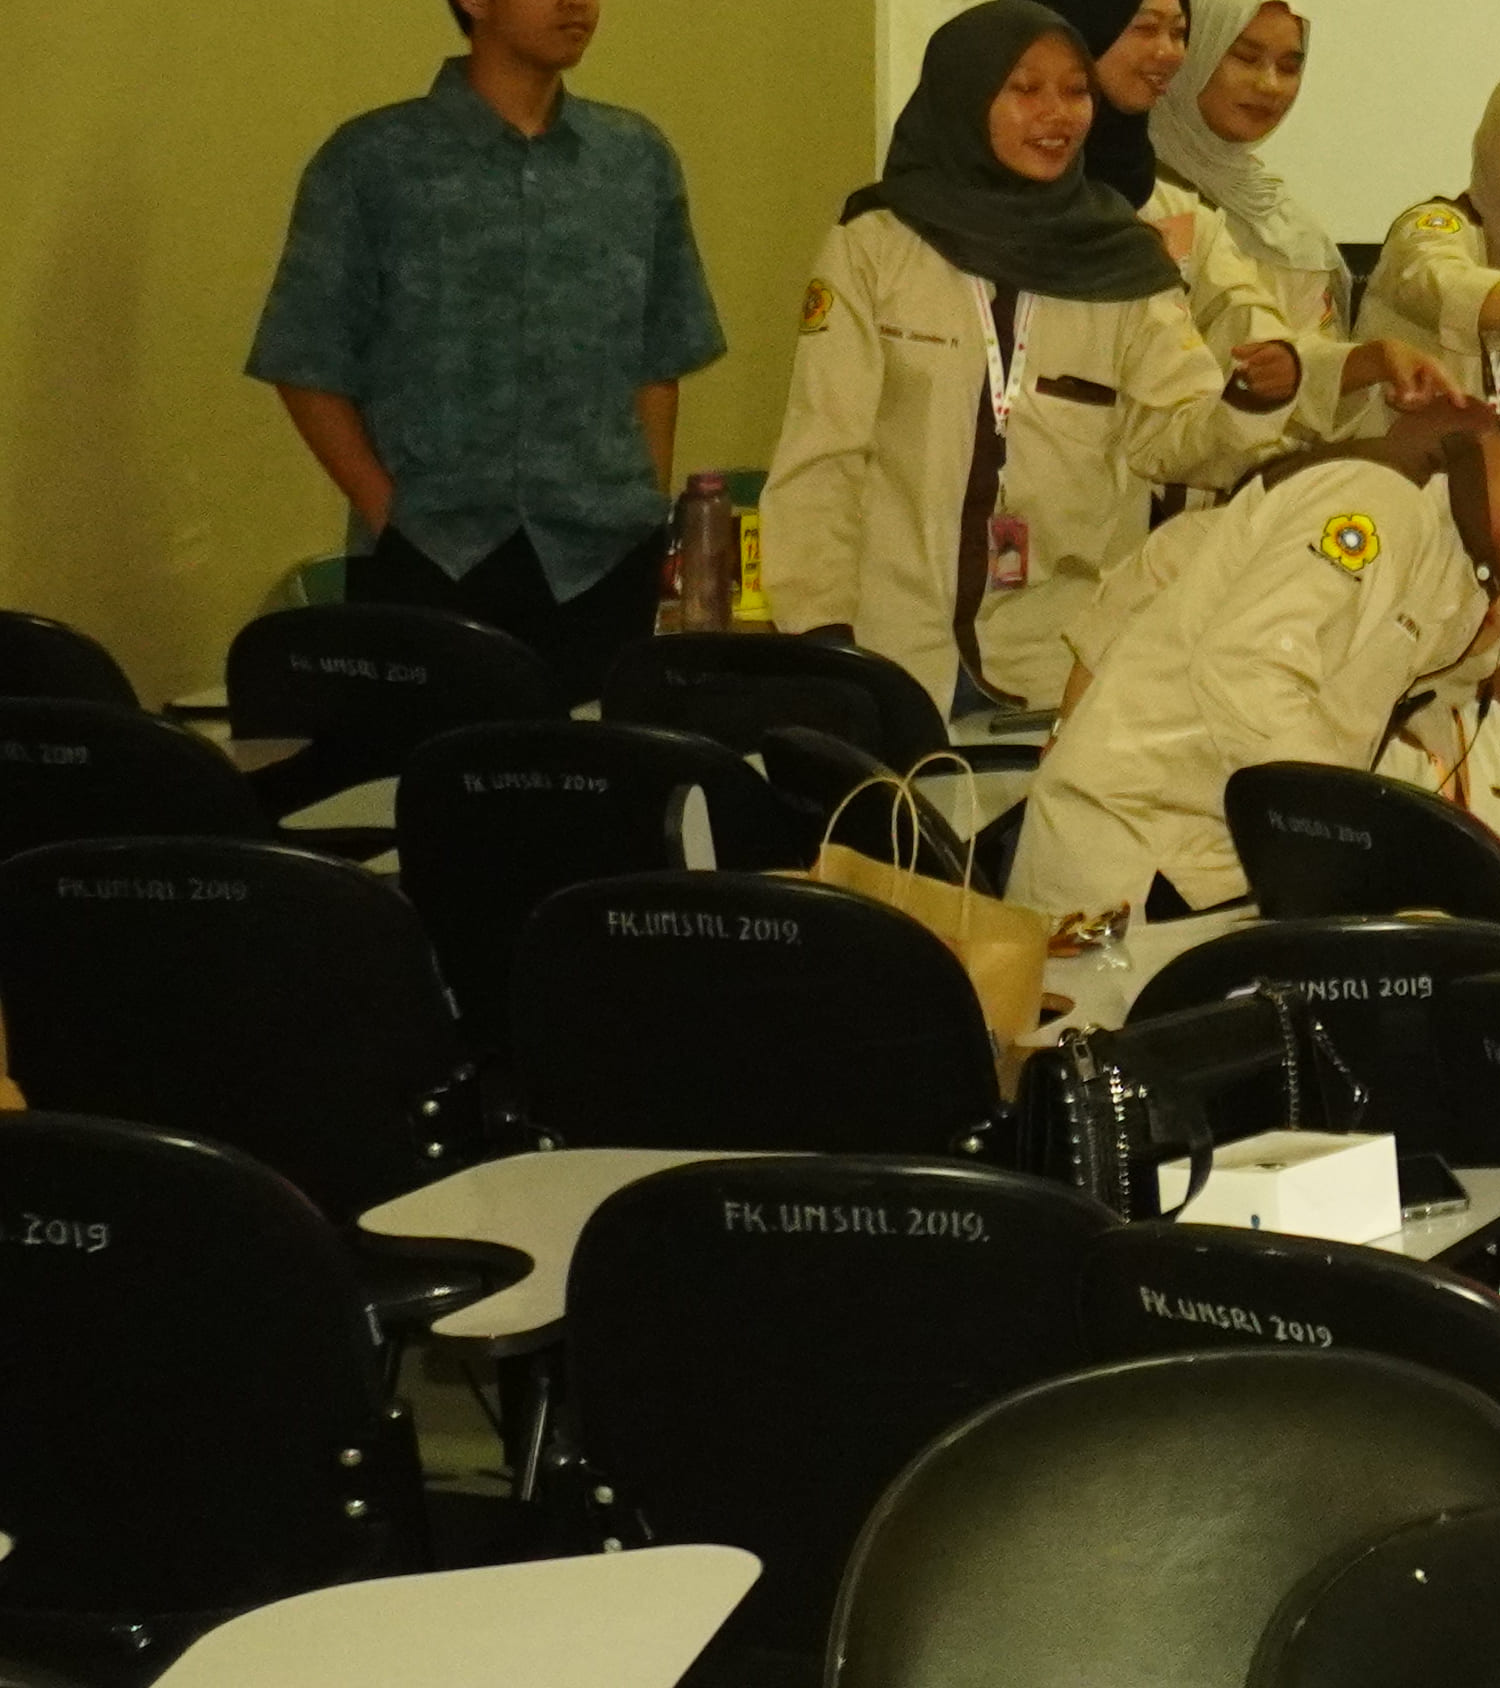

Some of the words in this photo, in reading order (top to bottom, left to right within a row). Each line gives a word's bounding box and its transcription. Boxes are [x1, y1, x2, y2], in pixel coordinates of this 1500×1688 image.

[1379, 976, 1433, 1000] 2019
[22, 1211, 110, 1253] 2019
[1268, 1313, 1334, 1349] 2019
